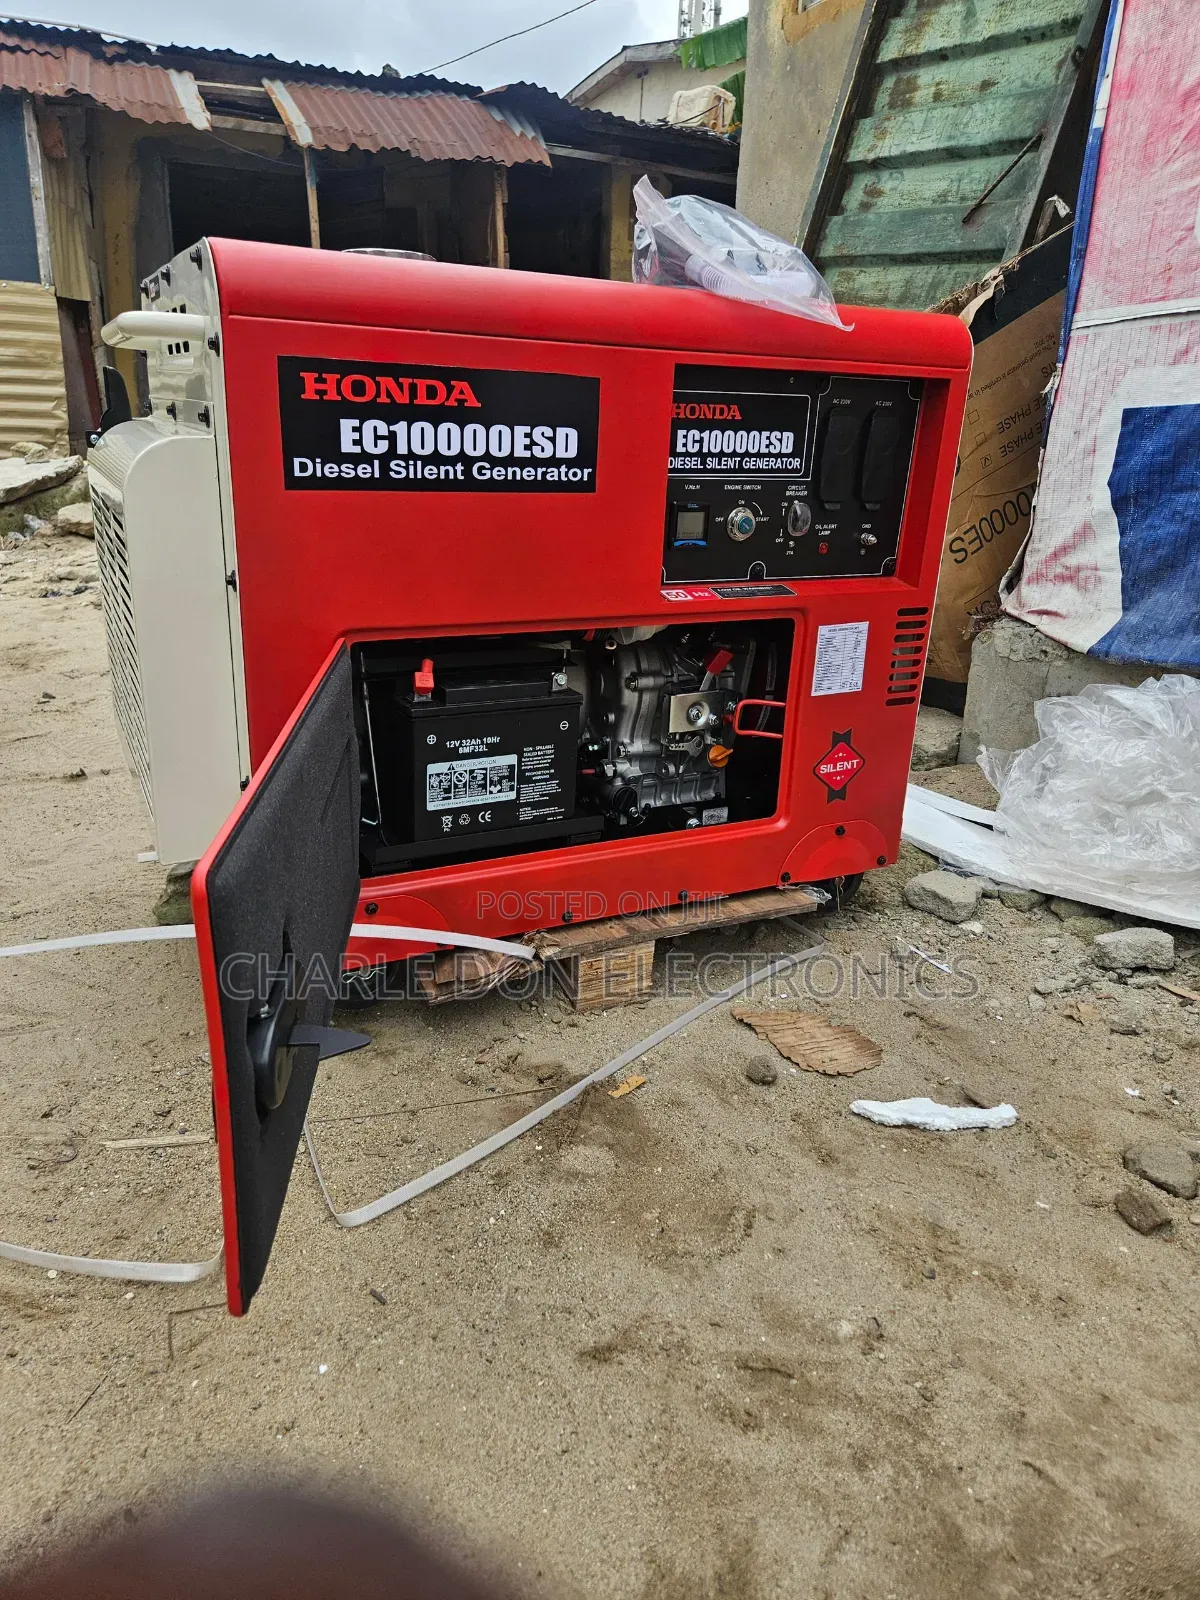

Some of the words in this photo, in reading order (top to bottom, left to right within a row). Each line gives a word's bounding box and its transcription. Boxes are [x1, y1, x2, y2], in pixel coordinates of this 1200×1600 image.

[1007, 357, 1029, 376] generator
[300, 371, 482, 408] HONDA
[980, 376, 1002, 392] certified
[671, 403, 742, 420] HONDA
[996, 403, 1032, 435] PHASE
[339, 417, 578, 459] EC10000ESD
[676, 429, 795, 454] EC10000ESD
[999, 427, 1034, 458] PHASE
[293, 457, 380, 478] Diesel
[389, 459, 465, 480] Silent
[472, 462, 593, 482] Generator
[668, 456, 704, 469] DIESEL
[706, 457, 741, 470] SILENT
[742, 457, 801, 470] GENERATOR
[667, 591, 690, 599] 50
[445, 739, 461, 748] 12V
[461, 738, 481, 747] 32Ah
[482, 736, 500, 744] 10Hr
[819, 759, 860, 774] SILENT
[478, 810, 492, 823] CE
